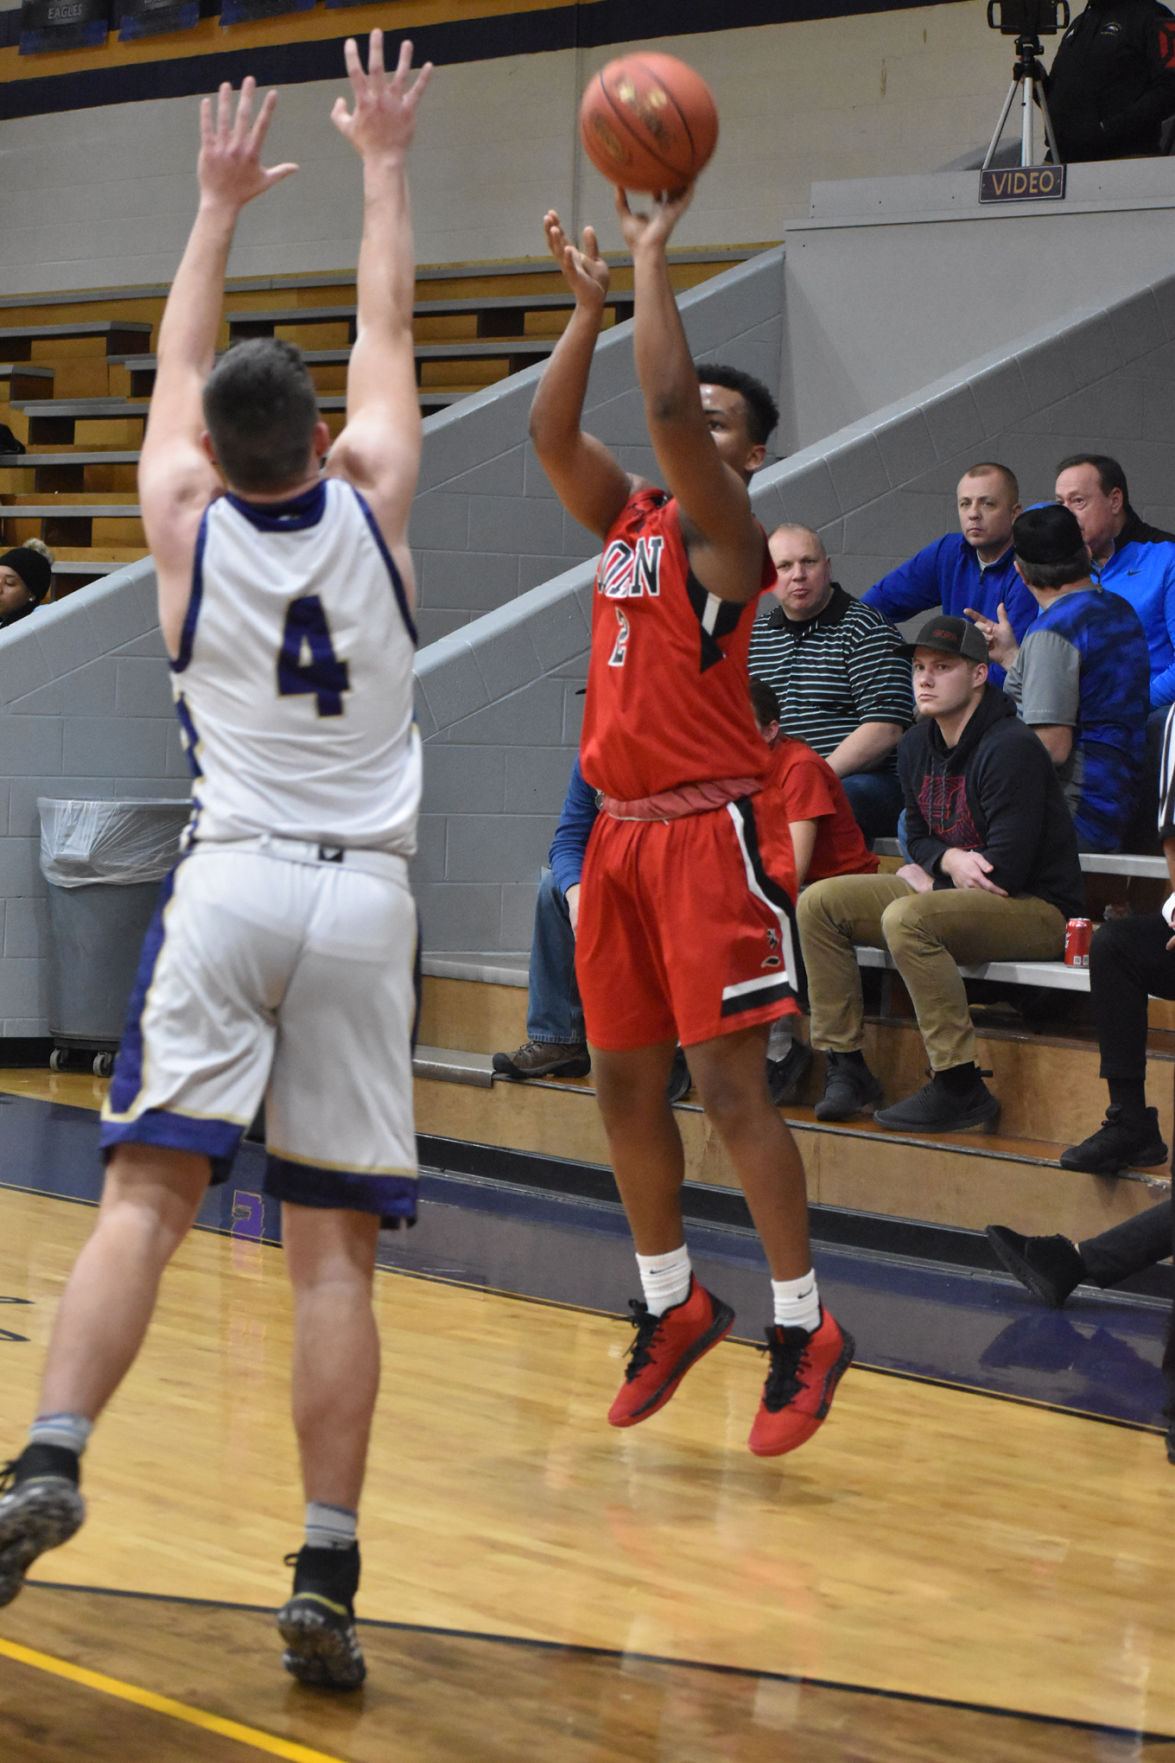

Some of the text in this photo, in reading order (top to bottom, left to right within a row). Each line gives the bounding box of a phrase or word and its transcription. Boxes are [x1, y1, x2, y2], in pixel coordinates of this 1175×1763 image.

[47, 3, 83, 19] EAGLES
[991, 170, 1055, 196] VIDEO
[275, 594, 352, 718] 4
